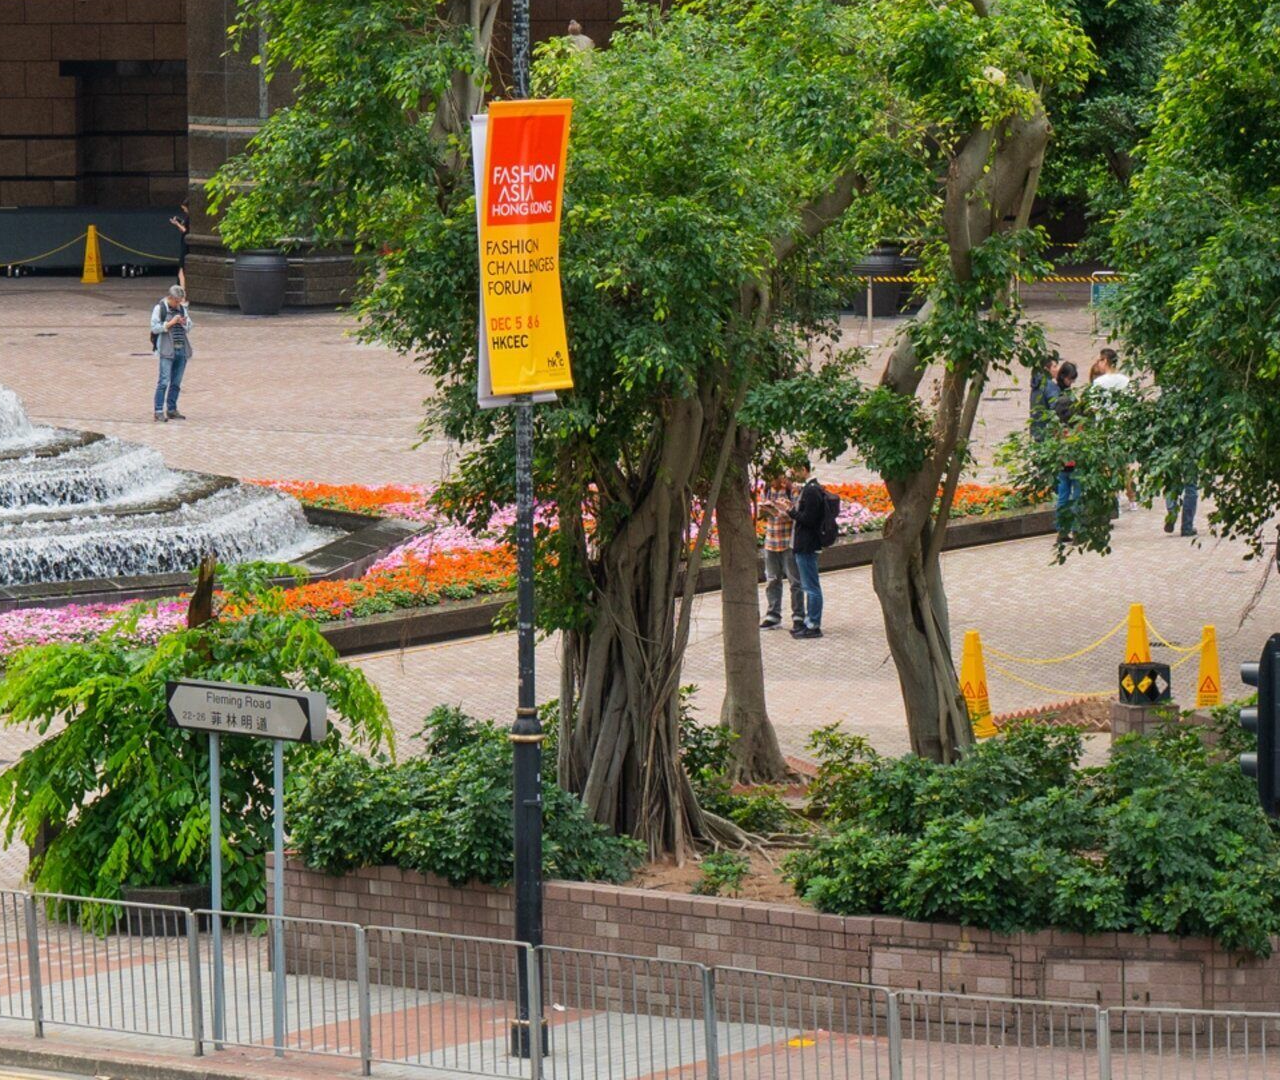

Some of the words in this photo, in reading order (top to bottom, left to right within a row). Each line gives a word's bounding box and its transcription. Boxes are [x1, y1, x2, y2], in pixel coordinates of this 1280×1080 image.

[493, 164, 555, 185] FASHION
[498, 184, 534, 202] ASIA
[492, 202, 528, 217] HONG
[487, 257, 555, 275] CHALLENGES
[488, 280, 532, 295] FORUM
[490, 316, 511, 331] DEC
[515, 316, 522, 330] 5
[492, 334, 528, 350] HKCEC
[206, 691, 242, 708] Fleming
[245, 695, 272, 709] Road
[182, 711, 206, 721] 22-26
[211, 711, 268, 732] 菲林明道
